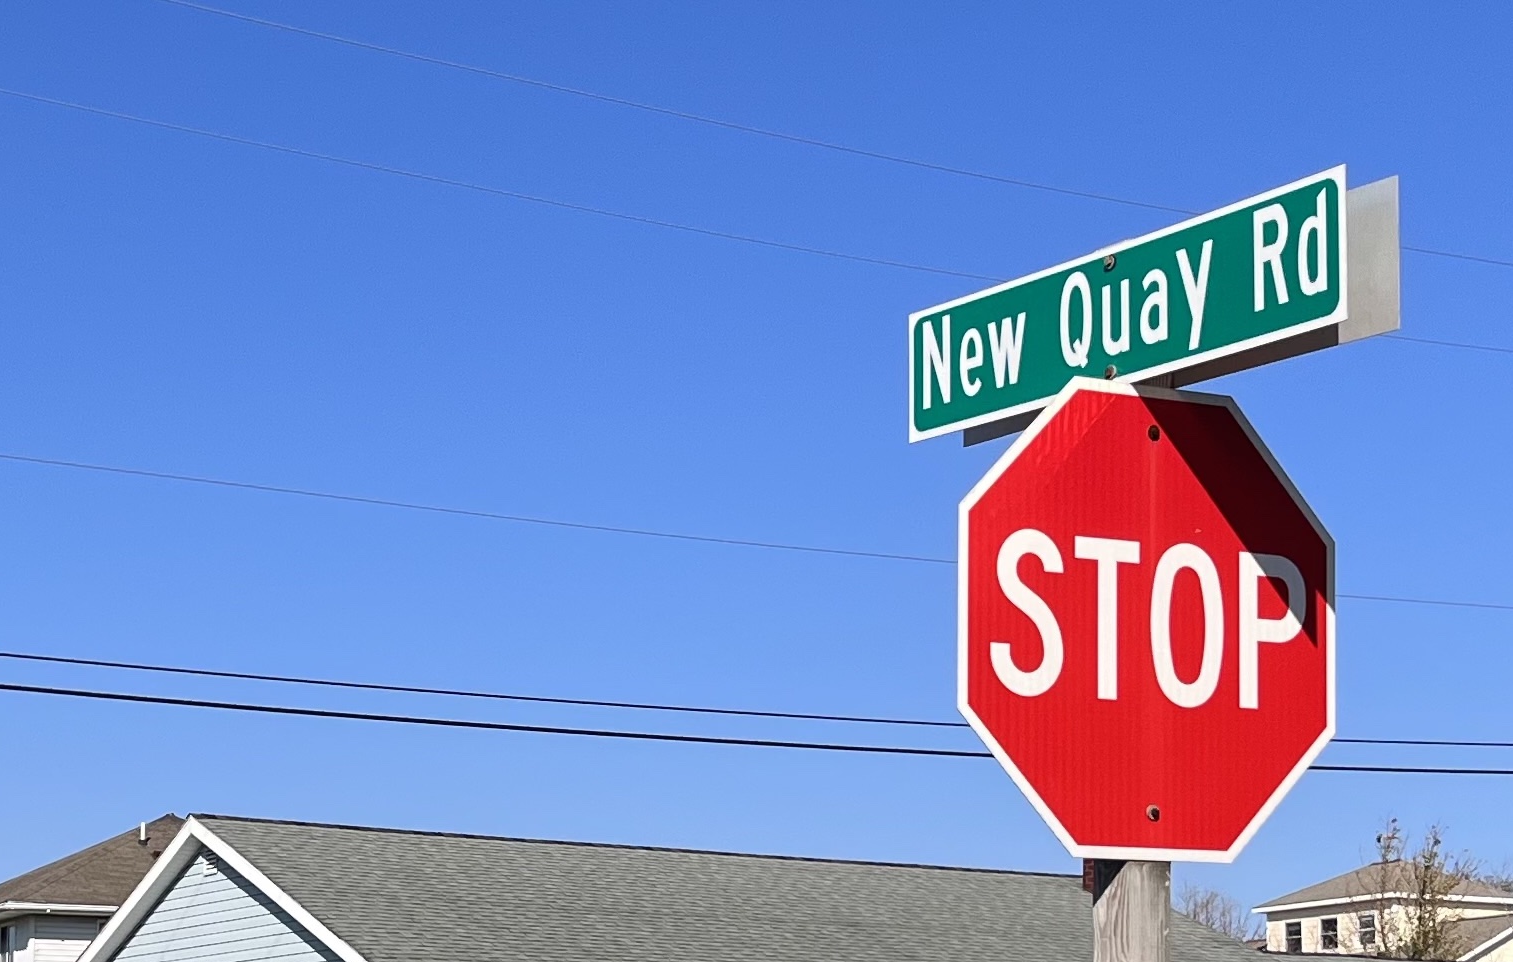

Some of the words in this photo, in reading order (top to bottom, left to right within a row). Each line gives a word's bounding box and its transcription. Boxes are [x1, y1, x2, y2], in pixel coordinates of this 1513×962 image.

[922, 312, 1026, 410] New
[1059, 238, 1213, 369] Quay
[1252, 187, 1328, 313] Rd
[989, 528, 1306, 710] STOP
